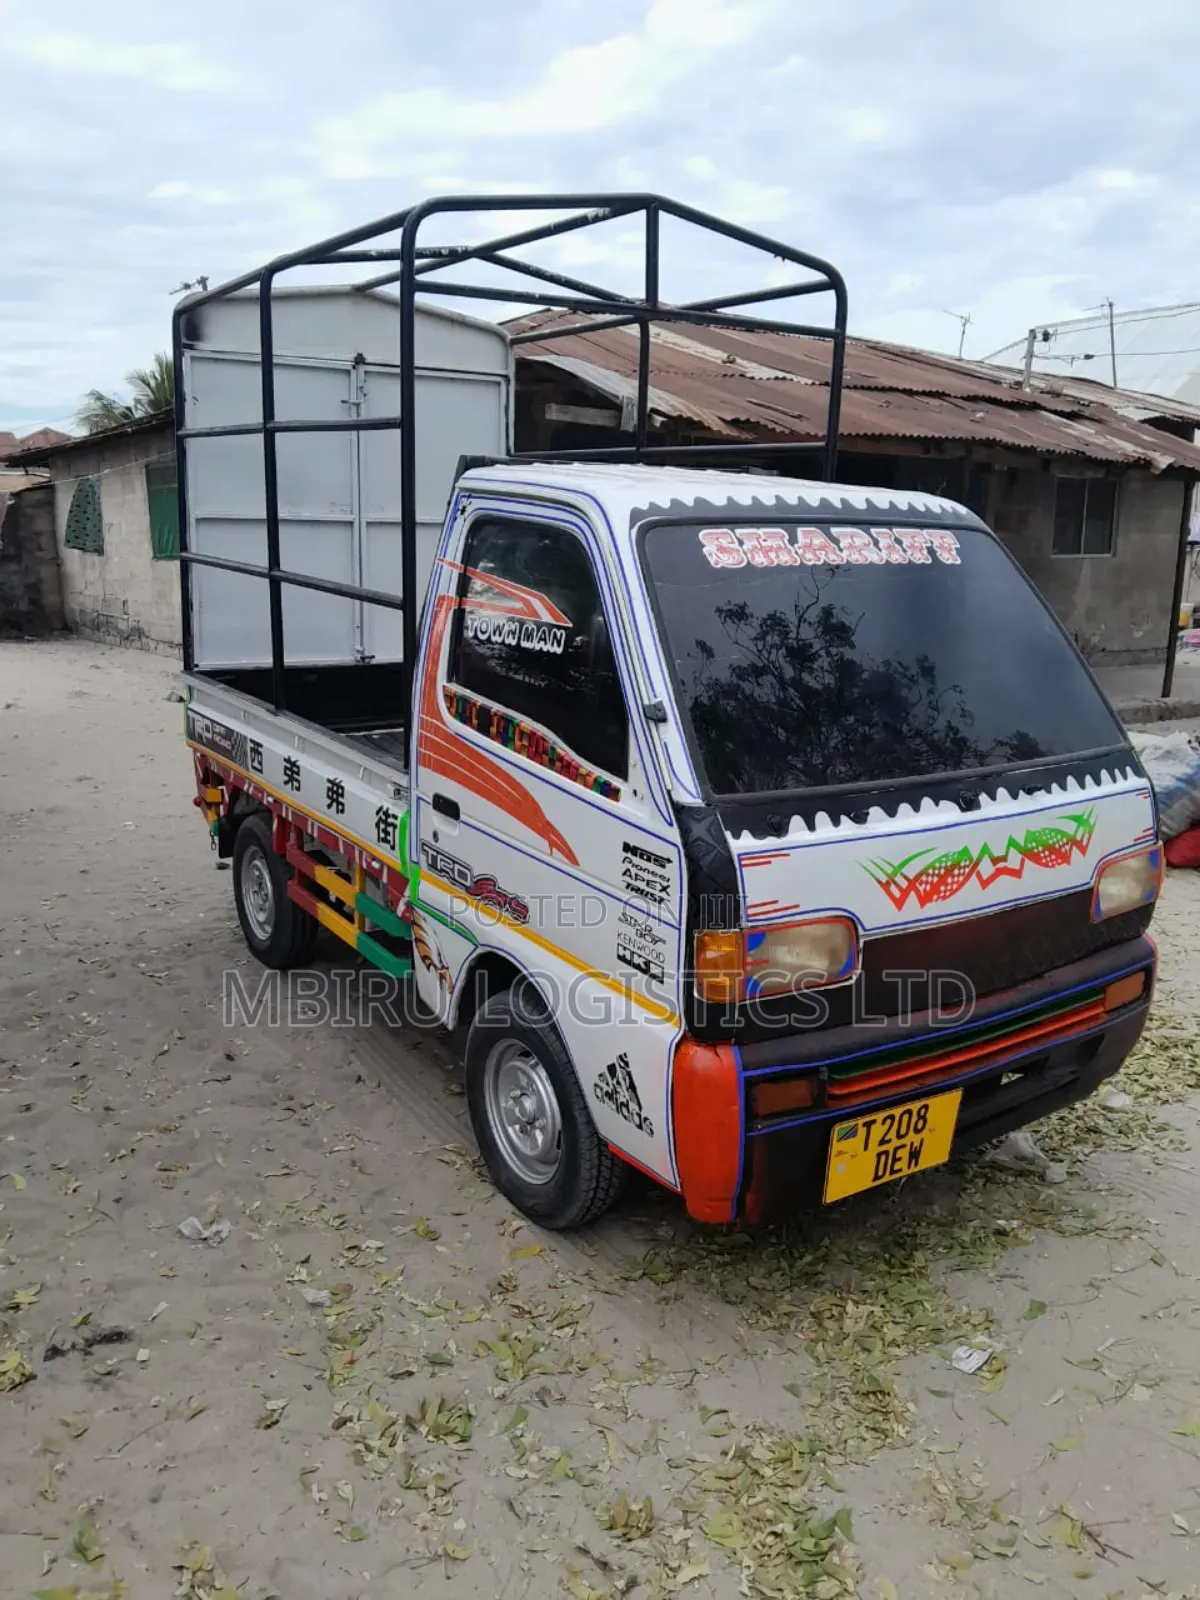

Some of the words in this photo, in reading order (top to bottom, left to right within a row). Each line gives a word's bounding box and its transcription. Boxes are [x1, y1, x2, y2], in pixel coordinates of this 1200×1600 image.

[699, 527, 961, 568] SHARIFF
[467, 616, 520, 645] TOWN
[520, 622, 566, 654] MAN
[421, 840, 474, 891] TRD
[621, 868, 671, 897] APEX
[621, 879, 671, 905] TRUST
[617, 930, 665, 964] KENWOOD
[593, 1082, 655, 1139] adidas
[862, 1103, 930, 1152] T208
[871, 1137, 925, 1183] DEW
